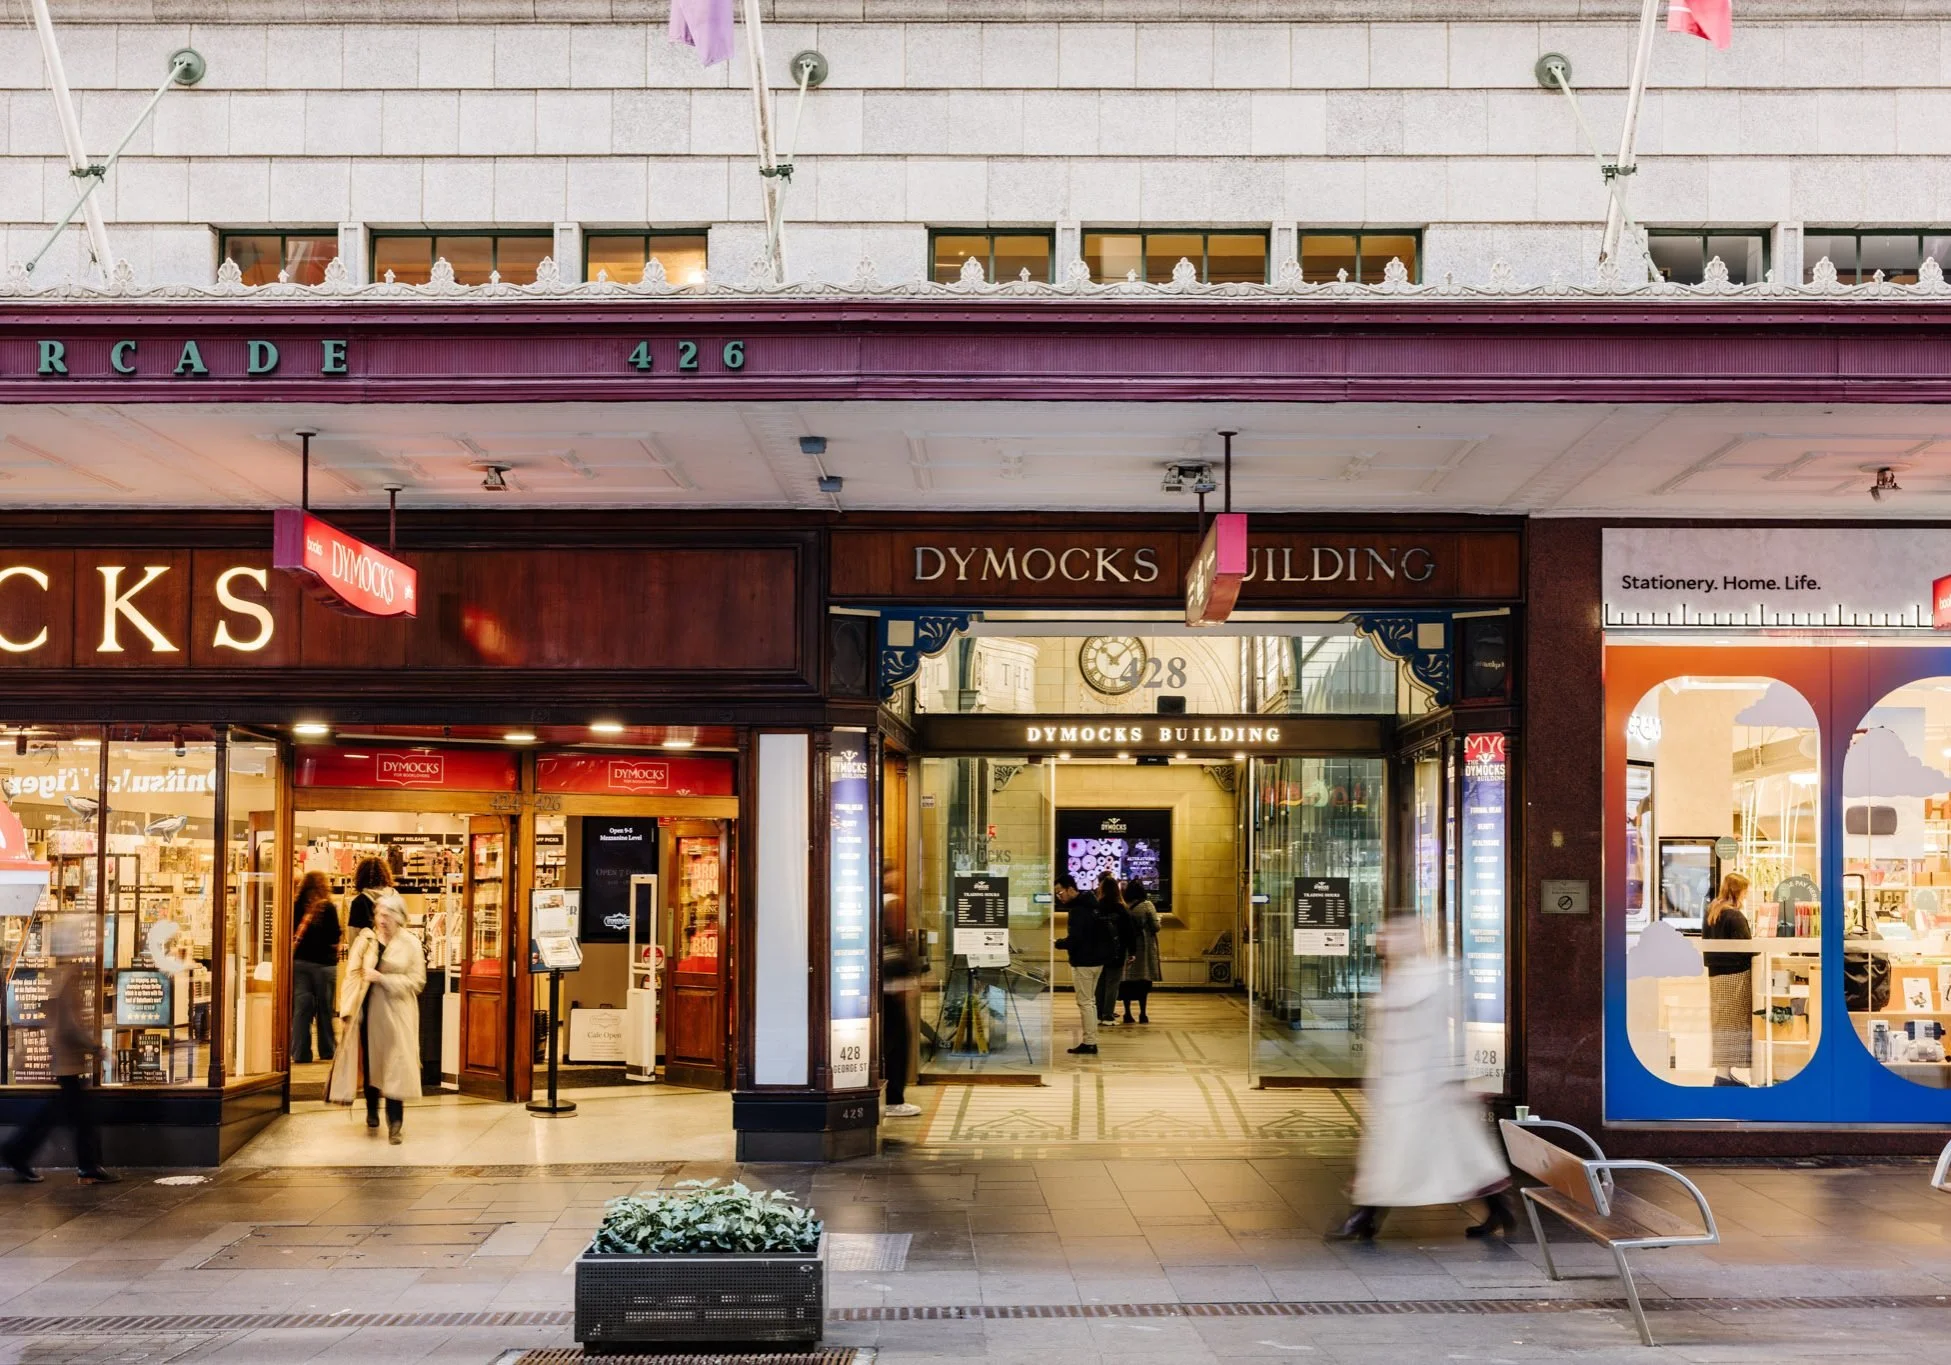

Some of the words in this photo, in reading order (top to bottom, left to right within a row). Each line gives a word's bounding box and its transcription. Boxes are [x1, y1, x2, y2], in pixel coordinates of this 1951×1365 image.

[37, 340, 348, 373] RCADE
[628, 340, 745, 369] 426
[306, 536, 323, 556] books
[914, 546, 1160, 582] DYMOCKS
[331, 540, 395, 605] DYMOCKS
[1621, 574, 1719, 593] Stationery.
[1723, 575, 1781, 591] Home.
[1785, 574, 1822, 591] Life.
[1119, 656, 1187, 689] 428
[1026, 726, 1143, 742] DYMOCKS
[1158, 726, 1281, 742] BUILDING
[383, 760, 440, 775] DYMOCKS
[613, 767, 665, 780] DYMOCKS
[830, 762, 868, 773] DYMOCKS
[1465, 764, 1506, 777] DYMOCKS
[609, 827, 623, 835] Open
[1100, 823, 1127, 831] DYMOCKS
[599, 834, 628, 842] Mezzanine
[628, 834, 643, 842] Level
[587, 1031, 602, 1039] Cafe
[603, 1031, 622, 1041] Open
[839, 1046, 861, 1061] 428
[1473, 1050, 1497, 1065] 428
[832, 1063, 858, 1074] GEORGE
[859, 1062, 868, 1072] ST
[842, 1107, 864, 1120] 428
